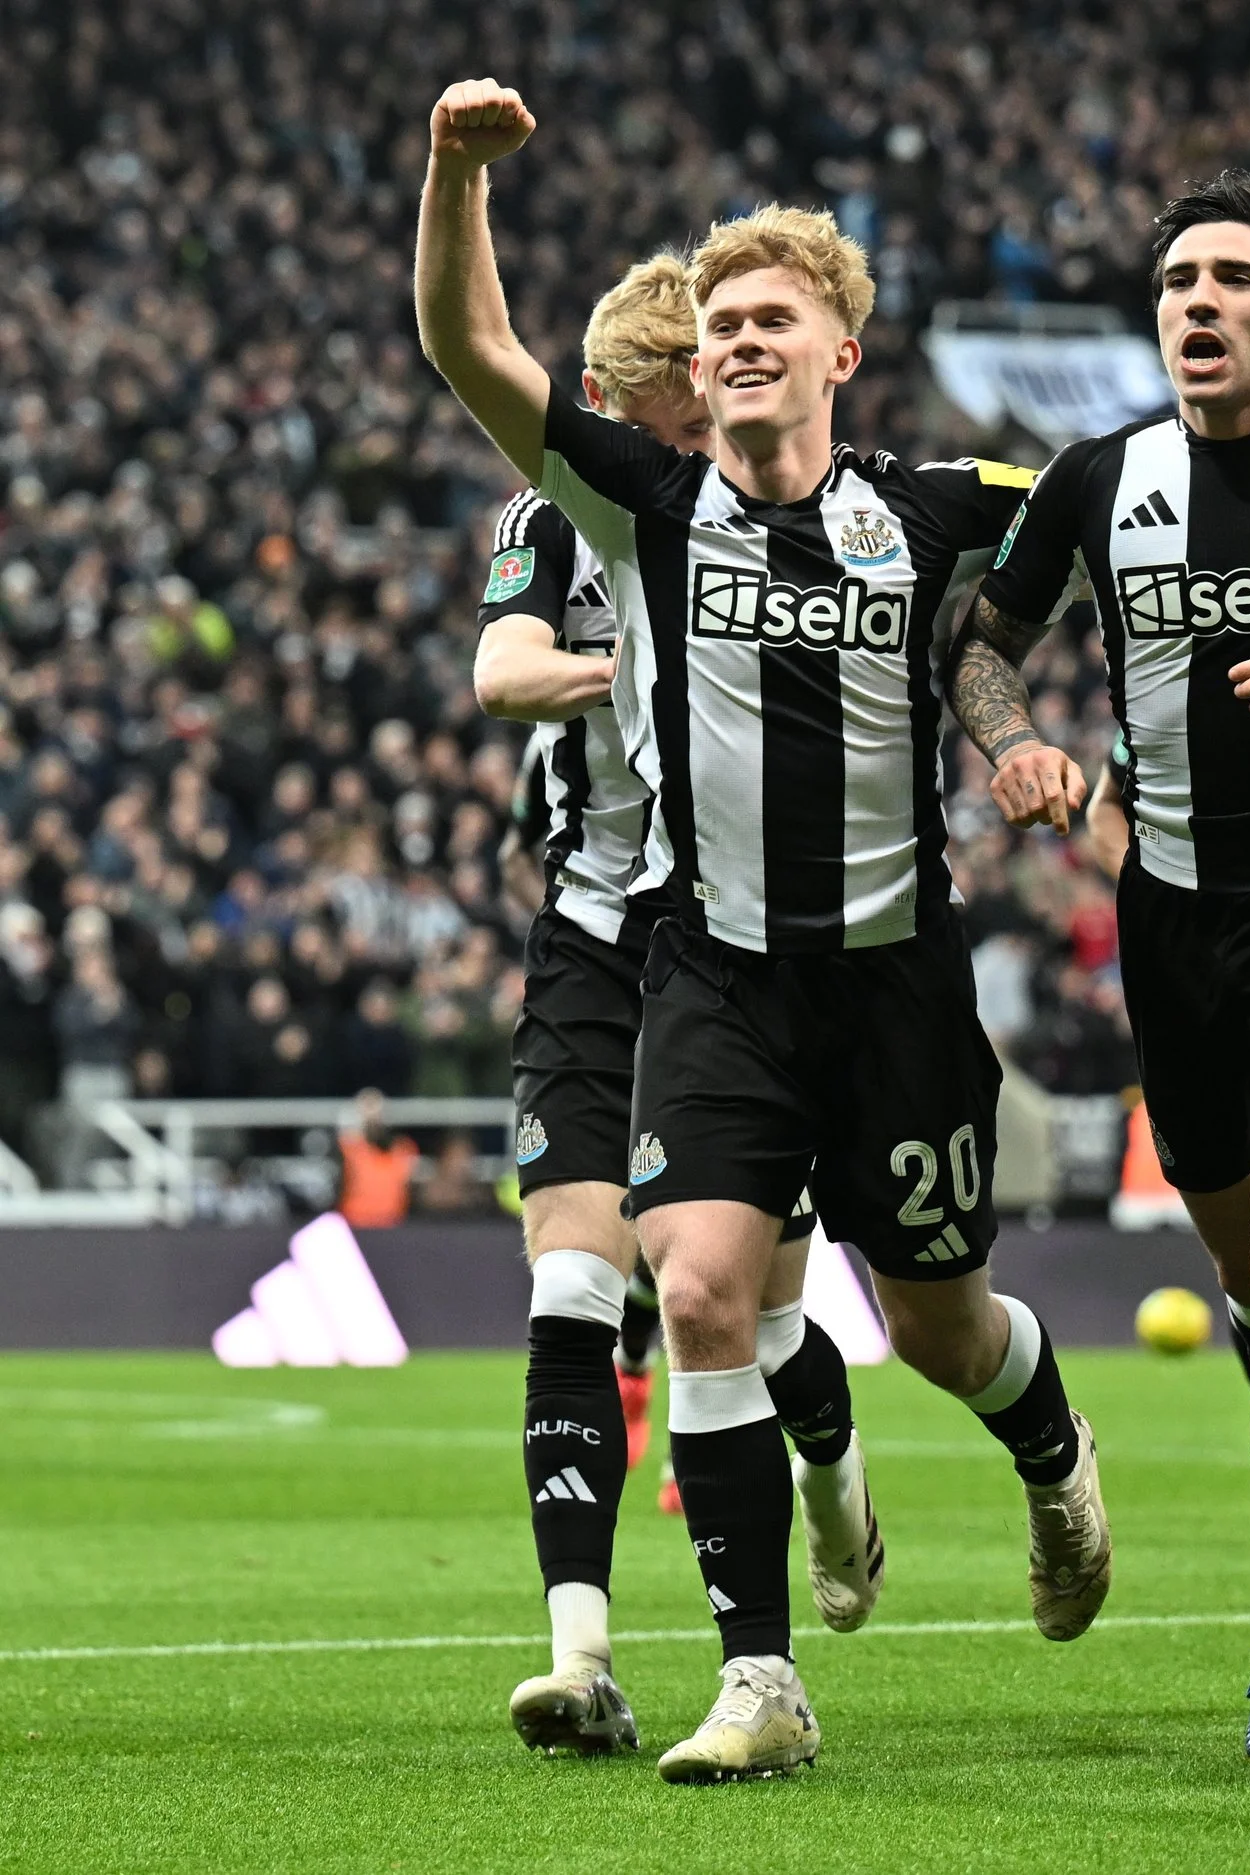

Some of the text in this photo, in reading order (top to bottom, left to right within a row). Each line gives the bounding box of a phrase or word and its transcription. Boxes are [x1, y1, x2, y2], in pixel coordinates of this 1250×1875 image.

[761, 585, 901, 646] sela
[890, 1123, 981, 1226] 20
[526, 1419, 601, 1446] NUFC
[693, 1537, 727, 1557] FC
